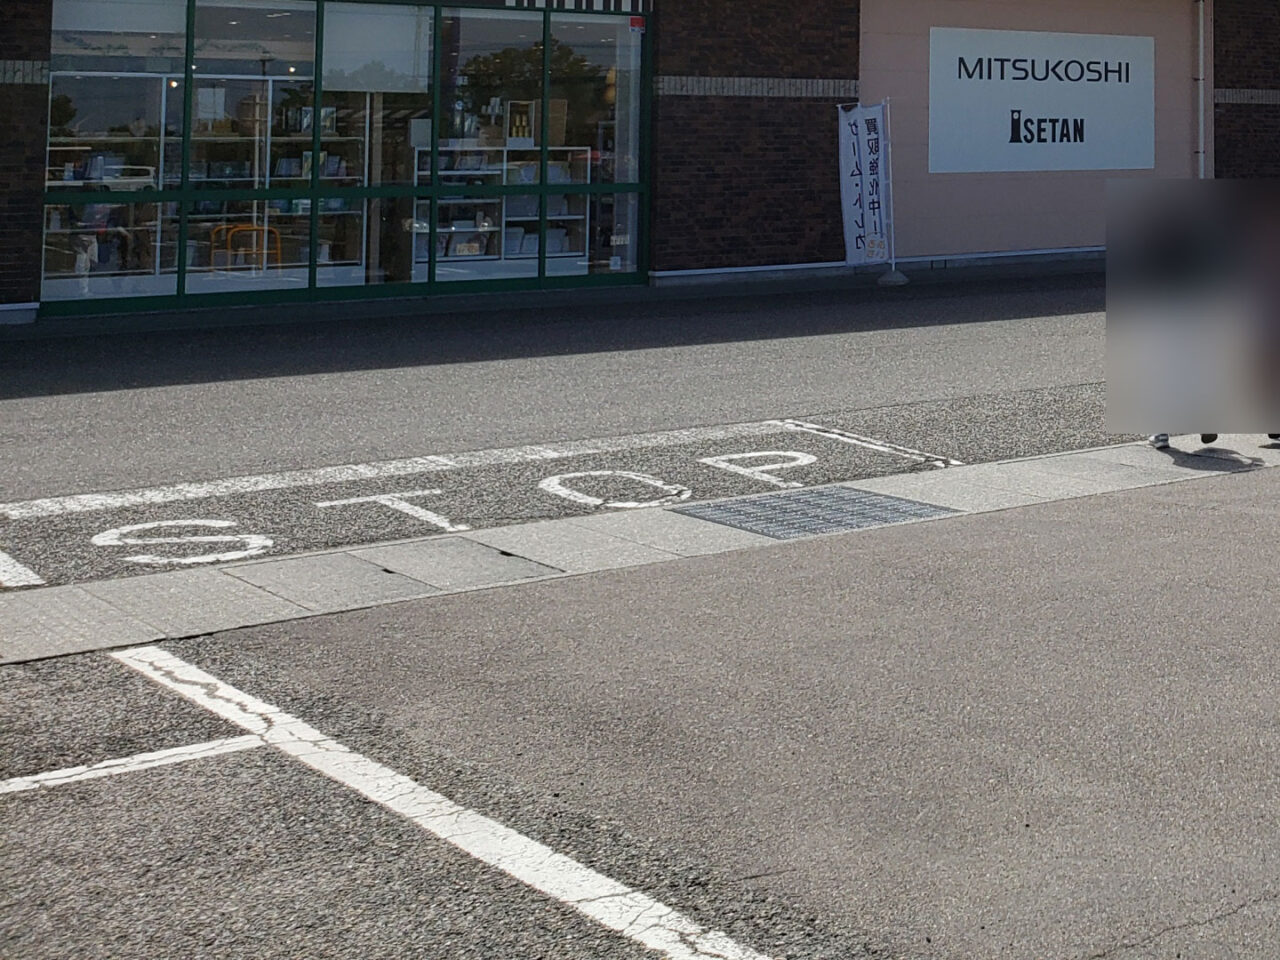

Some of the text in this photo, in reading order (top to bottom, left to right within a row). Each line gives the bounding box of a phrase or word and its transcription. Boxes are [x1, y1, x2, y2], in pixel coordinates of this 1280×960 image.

[957, 56, 1131, 84] MITSUKOSHI
[1008, 109, 1086, 144] ISETAN
[91, 450, 819, 564] STOP
